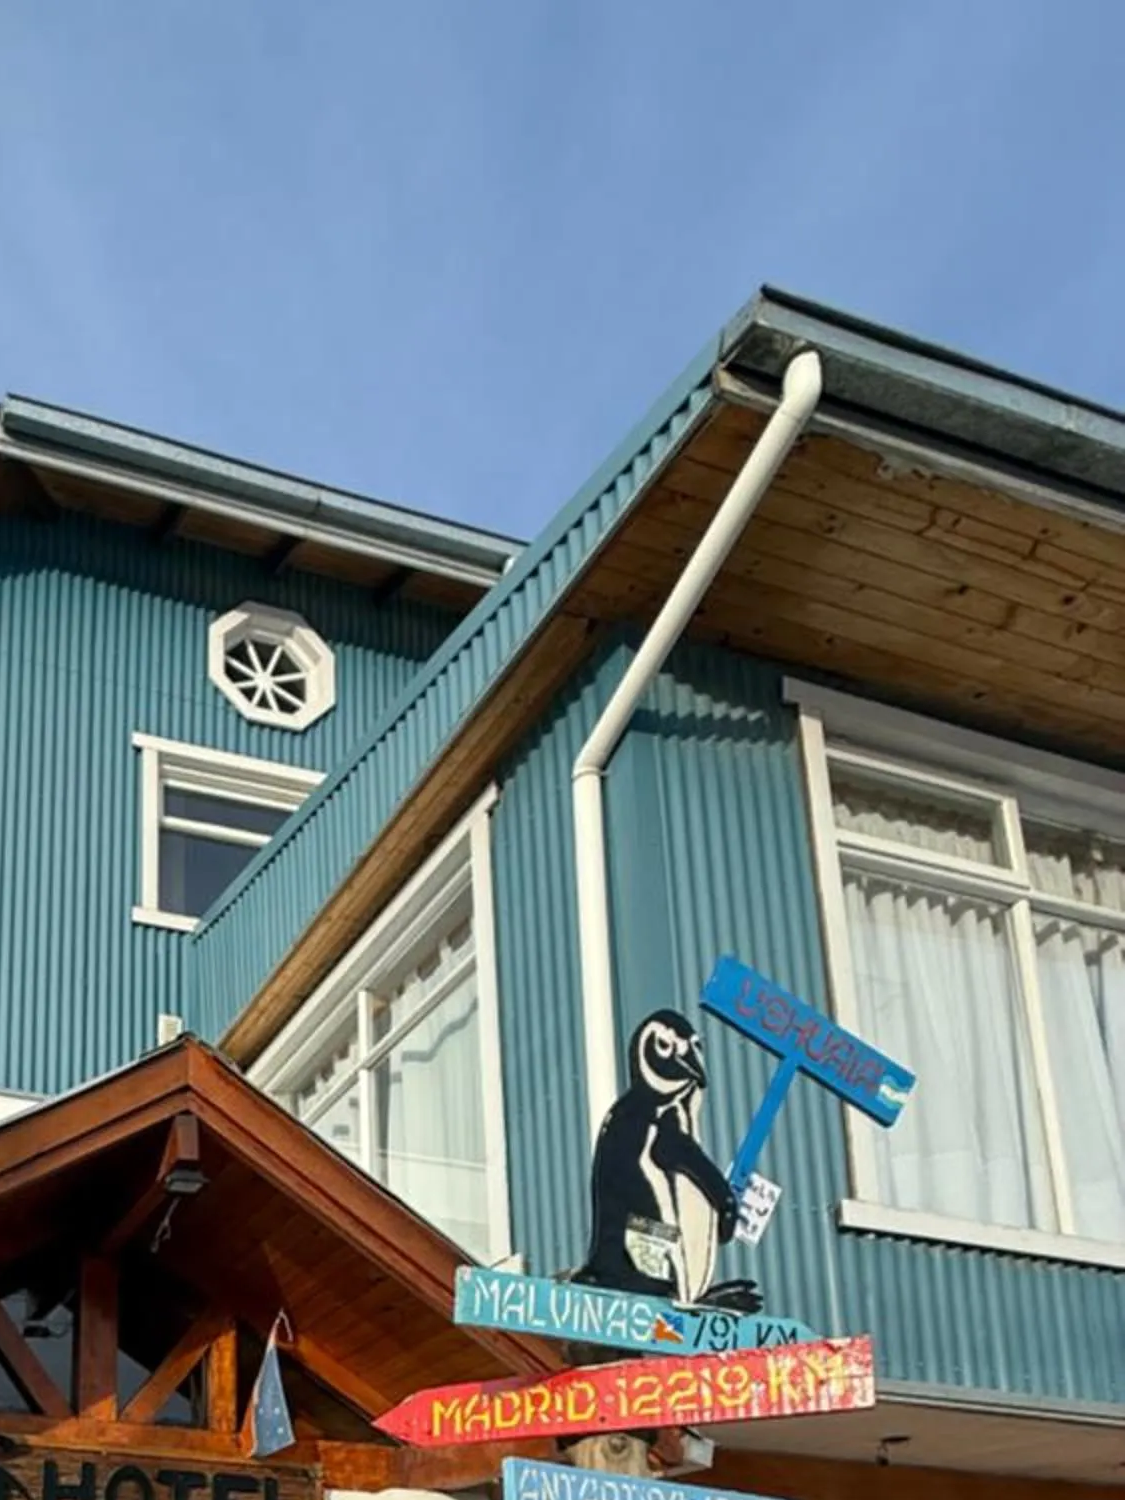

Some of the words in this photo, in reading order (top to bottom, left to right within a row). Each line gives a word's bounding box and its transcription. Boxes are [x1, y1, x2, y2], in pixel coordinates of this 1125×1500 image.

[735, 979, 883, 1093] USHUAIA
[475, 1277, 653, 1342] MALVINAS
[755, 1321, 798, 1348] KM
[431, 1380, 596, 1437] MADRID
[616, 1364, 750, 1418] 12219
[767, 1351, 845, 1405] KM
